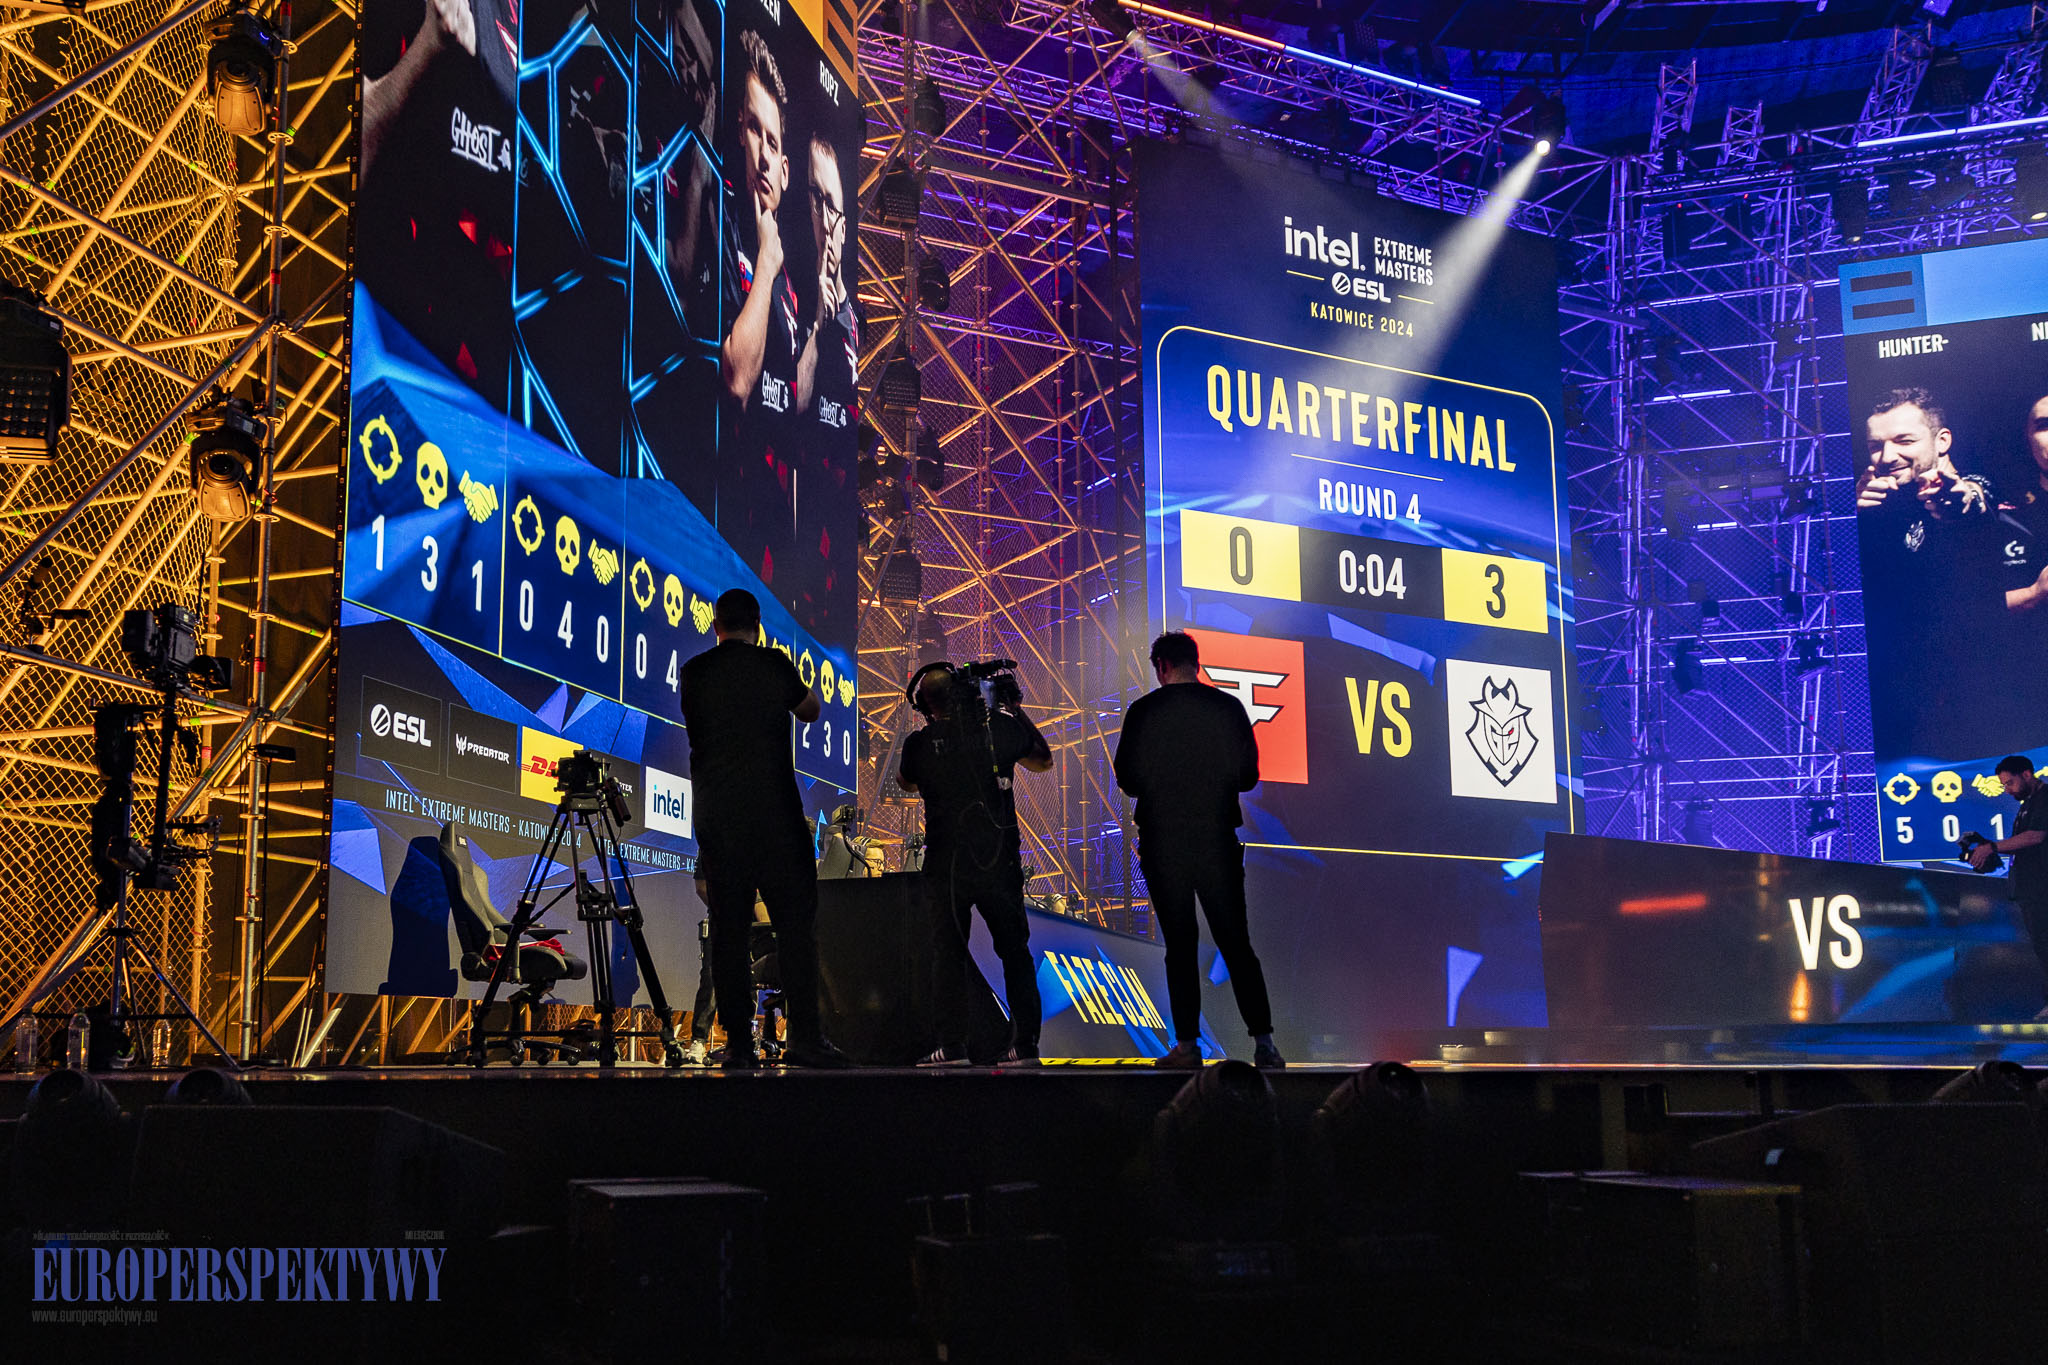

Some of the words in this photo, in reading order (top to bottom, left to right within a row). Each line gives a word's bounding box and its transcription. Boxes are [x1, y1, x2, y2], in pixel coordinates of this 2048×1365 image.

[820, 60, 839, 107] ROPZ
[451, 106, 502, 172] GHOST
[1374, 236, 1433, 267] EXTREME
[1375, 256, 1434, 287] MASTERS
[1353, 278, 1391, 304] ESL
[1310, 302, 1374, 331] KATOWICE
[1380, 316, 1414, 338] 2024
[762, 370, 785, 413] GHOST
[1206, 364, 1517, 473] QUARTERFINAL
[1318, 478, 1397, 521] ROUND
[1405, 493, 1422, 525] 4
[371, 514, 385, 572] 1
[421, 536, 438, 592] 3
[472, 559, 483, 612] 1
[1229, 525, 1254, 586] 0
[1338, 549, 1407, 600] 0:04
[1484, 563, 1506, 619] 3
[519, 580, 534, 632] 0
[557, 601, 574, 648] 4
[597, 615, 609, 663] 0
[635, 633, 647, 680] 0
[666, 649, 678, 693] 4
[393, 711, 432, 748] ESL
[1344, 676, 1413, 759] VS
[467, 742, 510, 765] PREDATOR
[823, 720, 831, 758] 3
[843, 730, 850, 766] 0
[421, 797, 466, 825] EXTREME
[468, 808, 510, 834] MASTERS
[561, 830, 582, 849] 204
[1896, 816, 1914, 844] 5
[1942, 814, 1960, 843] 0
[1990, 813, 2004, 841] 1
[620, 843, 650, 864] EXTREME
[652, 850, 681, 871] MASTERS
[1788, 894, 1864, 971] VS
[1044, 950, 1127, 1026] FAZE
[1097, 960, 1167, 1030] CLAN
